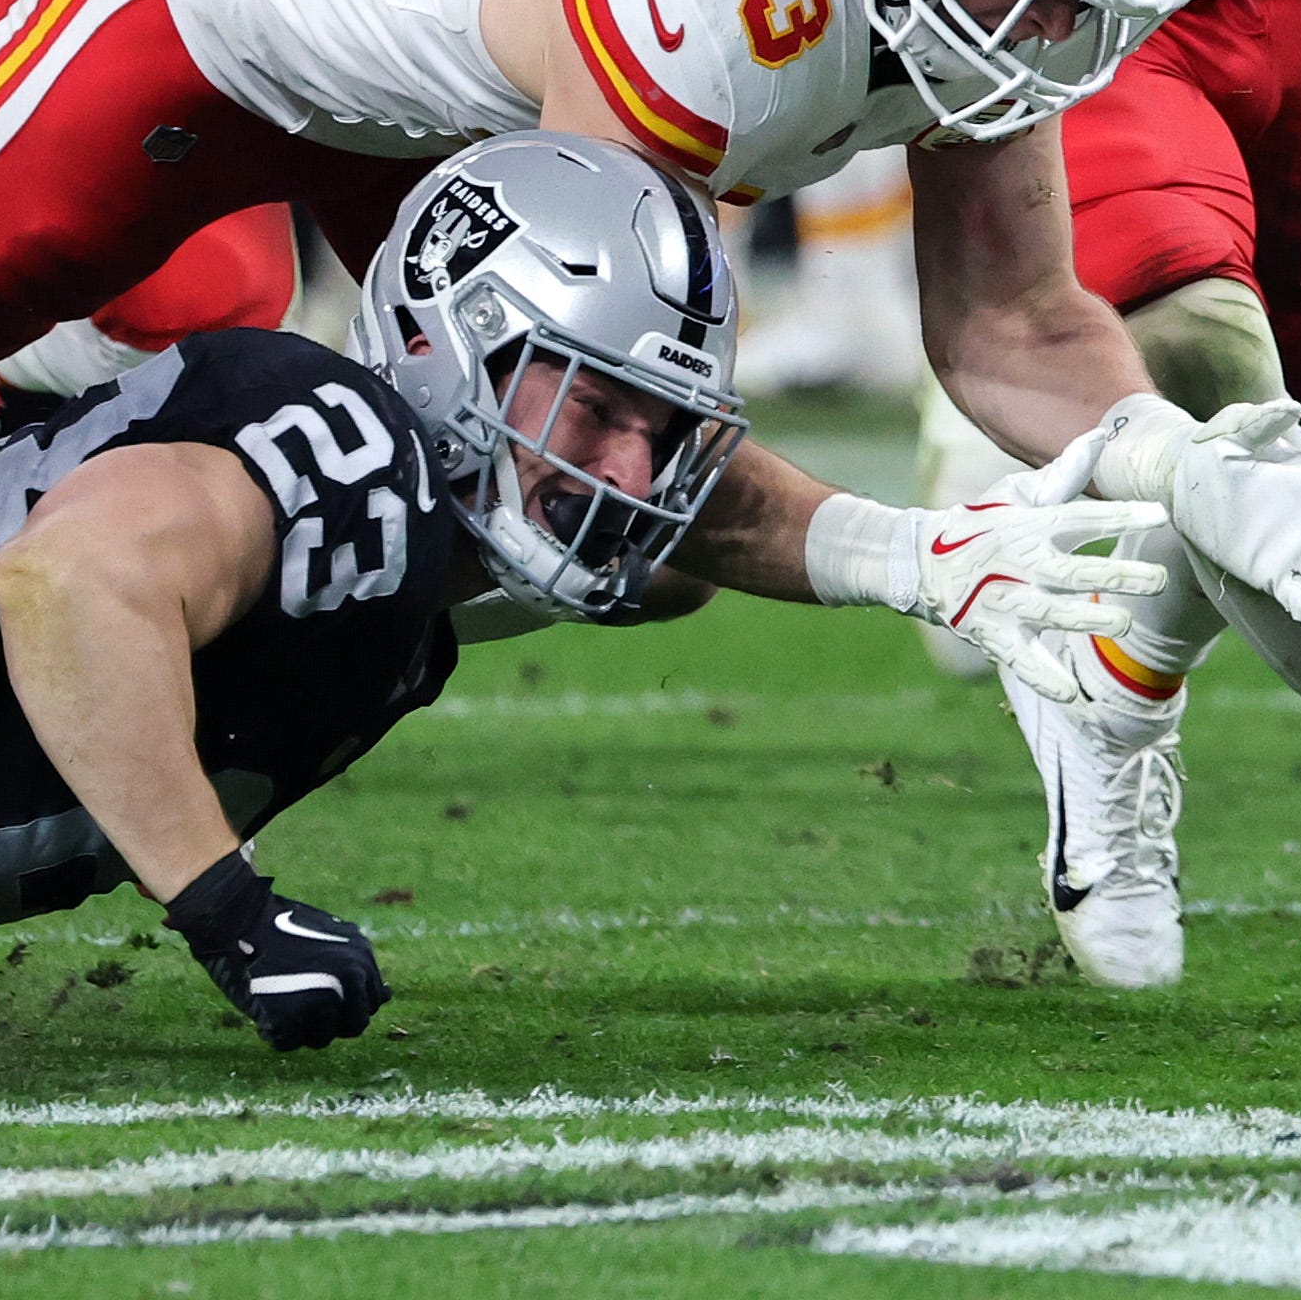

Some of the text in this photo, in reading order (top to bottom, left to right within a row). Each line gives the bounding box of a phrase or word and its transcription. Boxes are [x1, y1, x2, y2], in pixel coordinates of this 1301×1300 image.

[448, 181, 510, 232] RAIDERS
[657, 344, 712, 378] RAIDERS
[237, 382, 412, 618] 23
